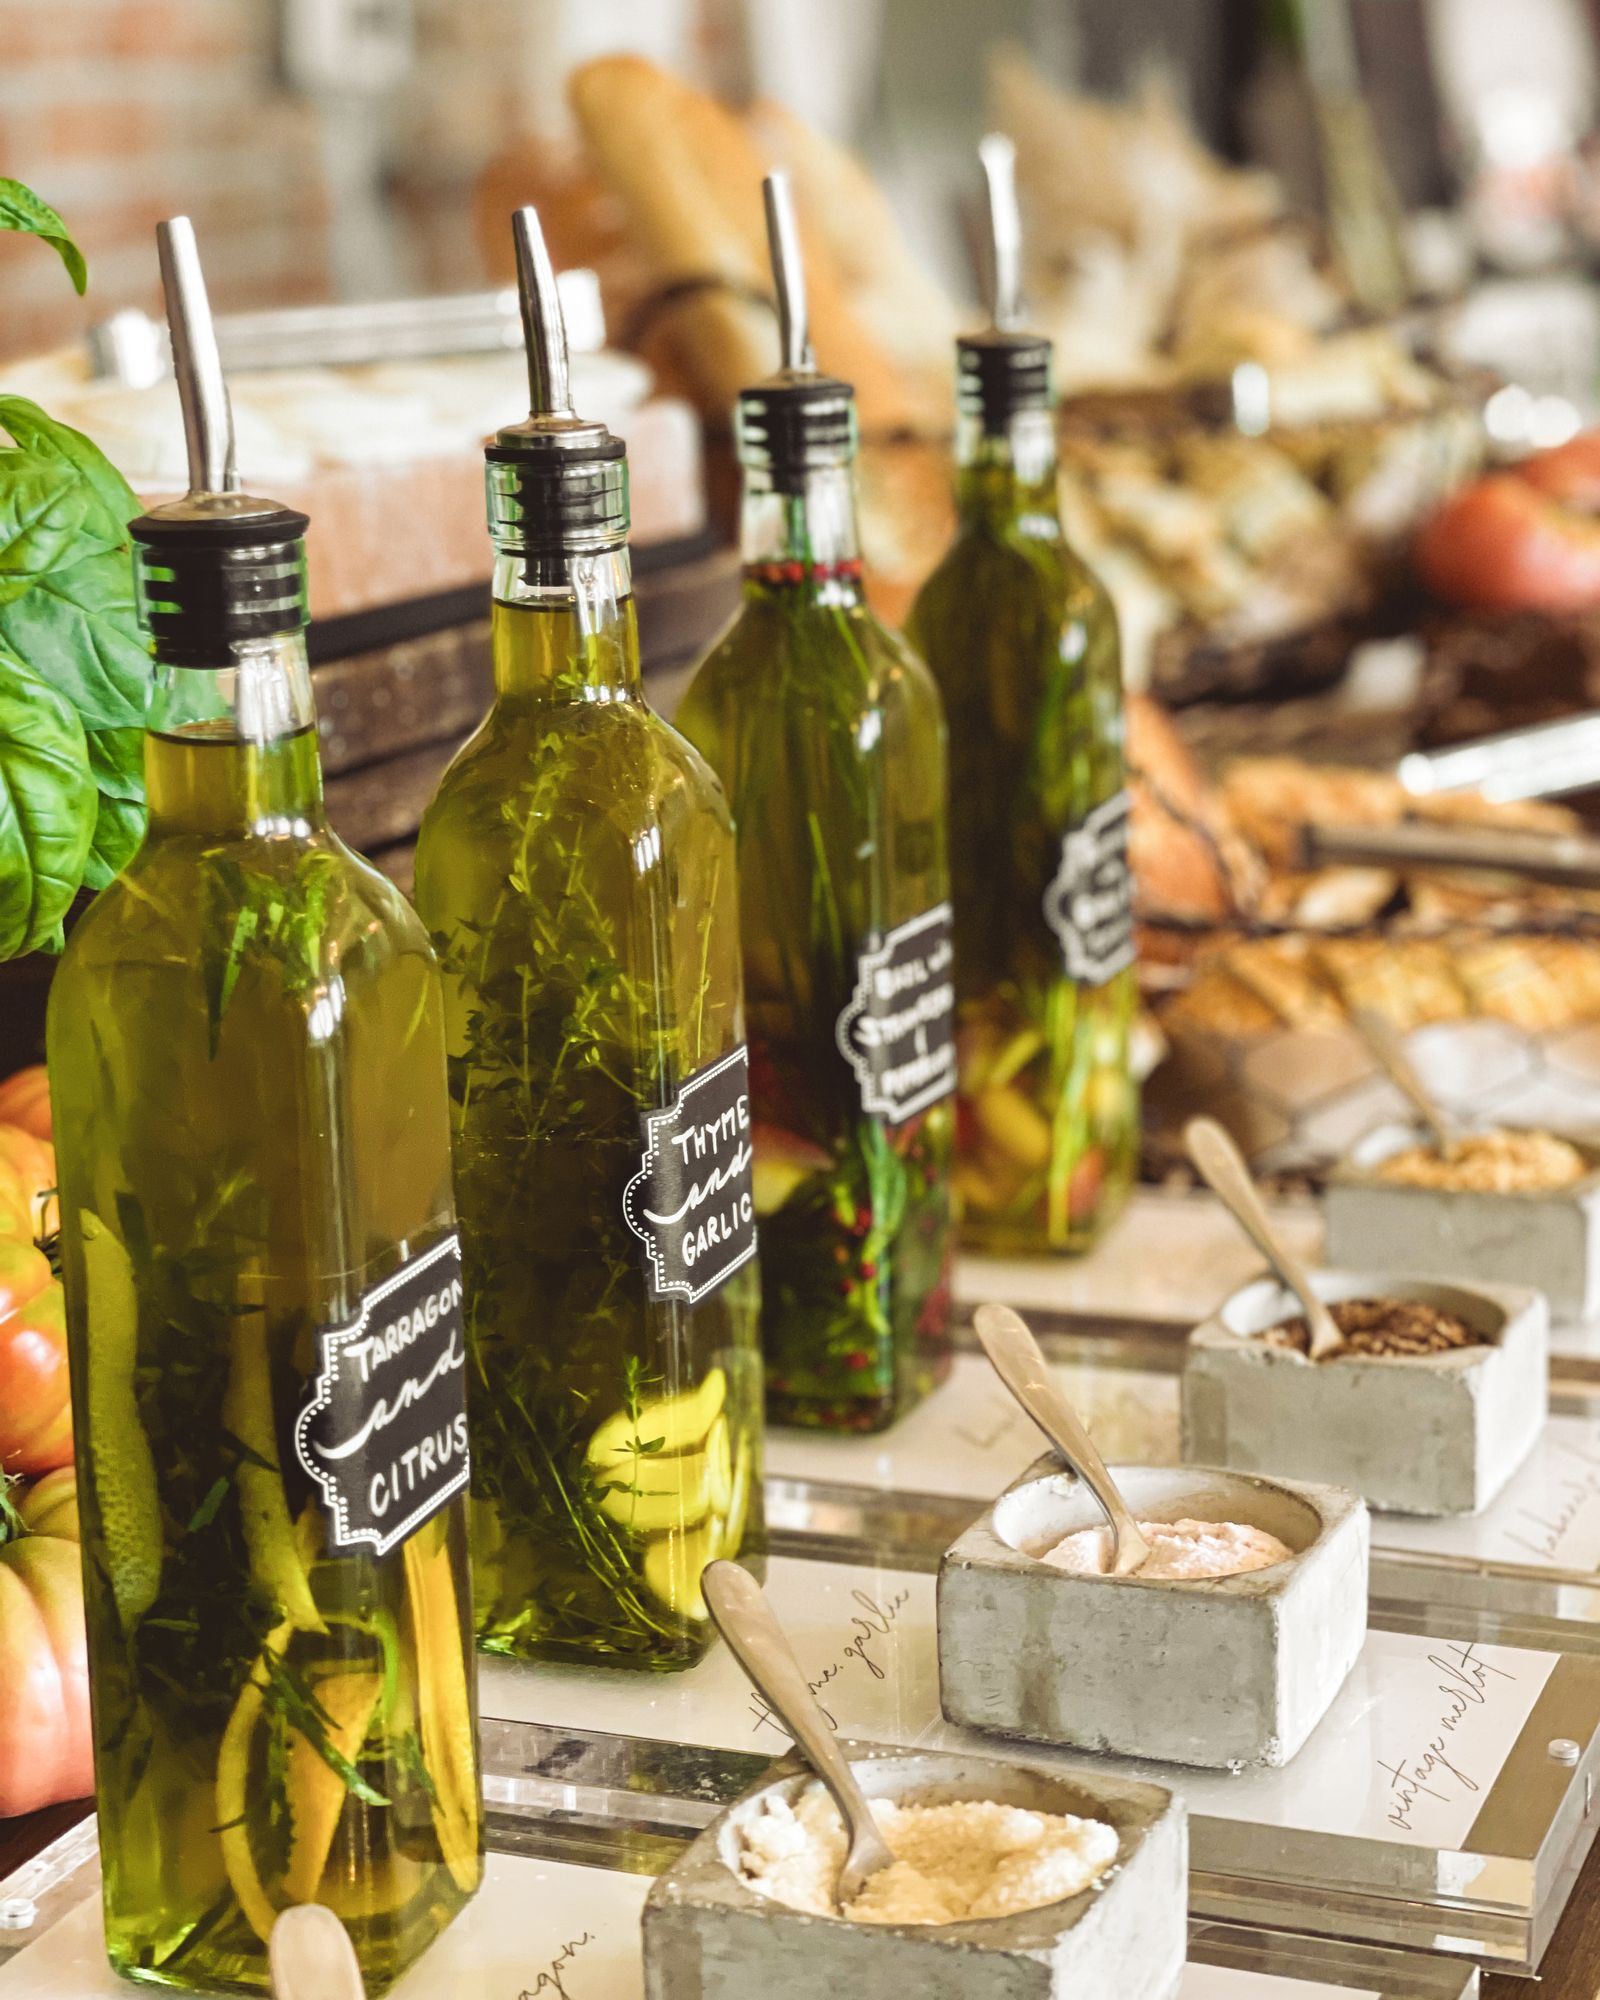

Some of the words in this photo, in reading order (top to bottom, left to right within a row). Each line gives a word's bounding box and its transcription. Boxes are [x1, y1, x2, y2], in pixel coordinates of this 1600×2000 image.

[671, 1095, 750, 1165] THYME
[643, 1141, 753, 1225] and
[682, 1192, 752, 1267] GARLIC
[313, 1328, 465, 1460] and
[370, 1413, 467, 1517] CITRUS
[1377, 1736, 1479, 1831] vintage
